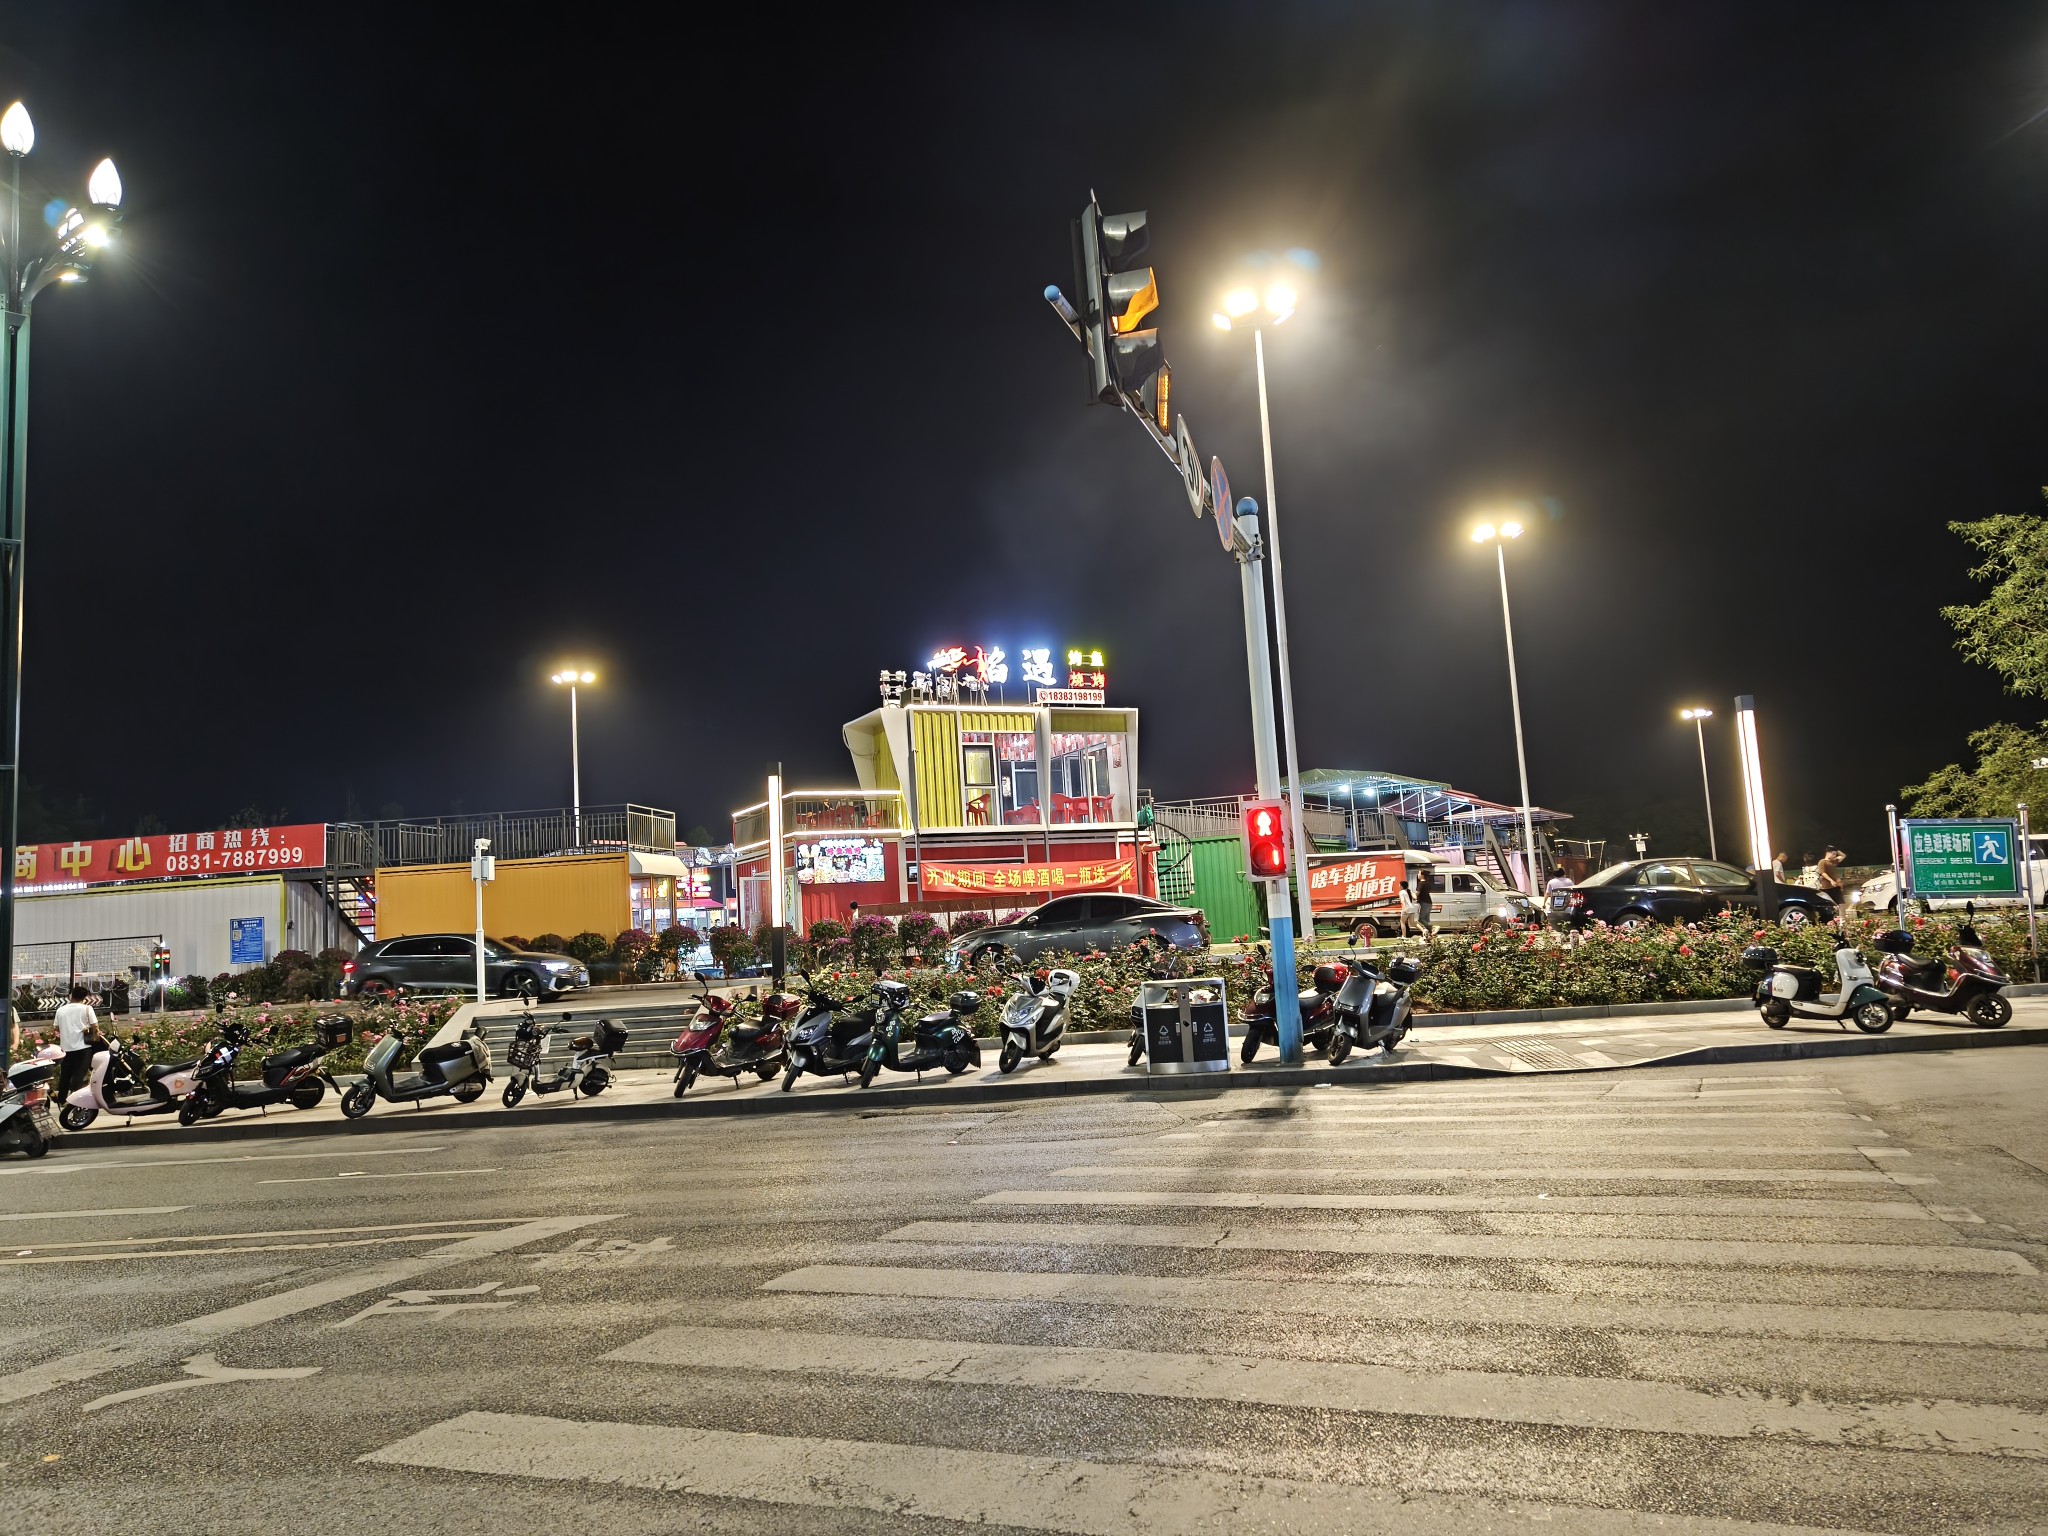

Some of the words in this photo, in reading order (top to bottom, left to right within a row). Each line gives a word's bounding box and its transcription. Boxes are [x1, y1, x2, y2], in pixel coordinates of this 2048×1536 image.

[1048, 690, 1103, 702] 18383198199
[1914, 832, 1972, 853] 应急避难场所
[166, 846, 303, 872] 0831-7887999
[926, 868, 987, 888] 开业期间
[992, 863, 1134, 888] 全场啤酒喝一瓶送一瓶
[1311, 860, 1378, 889] 啥车都有
[1344, 876, 1397, 902] 都便宜
